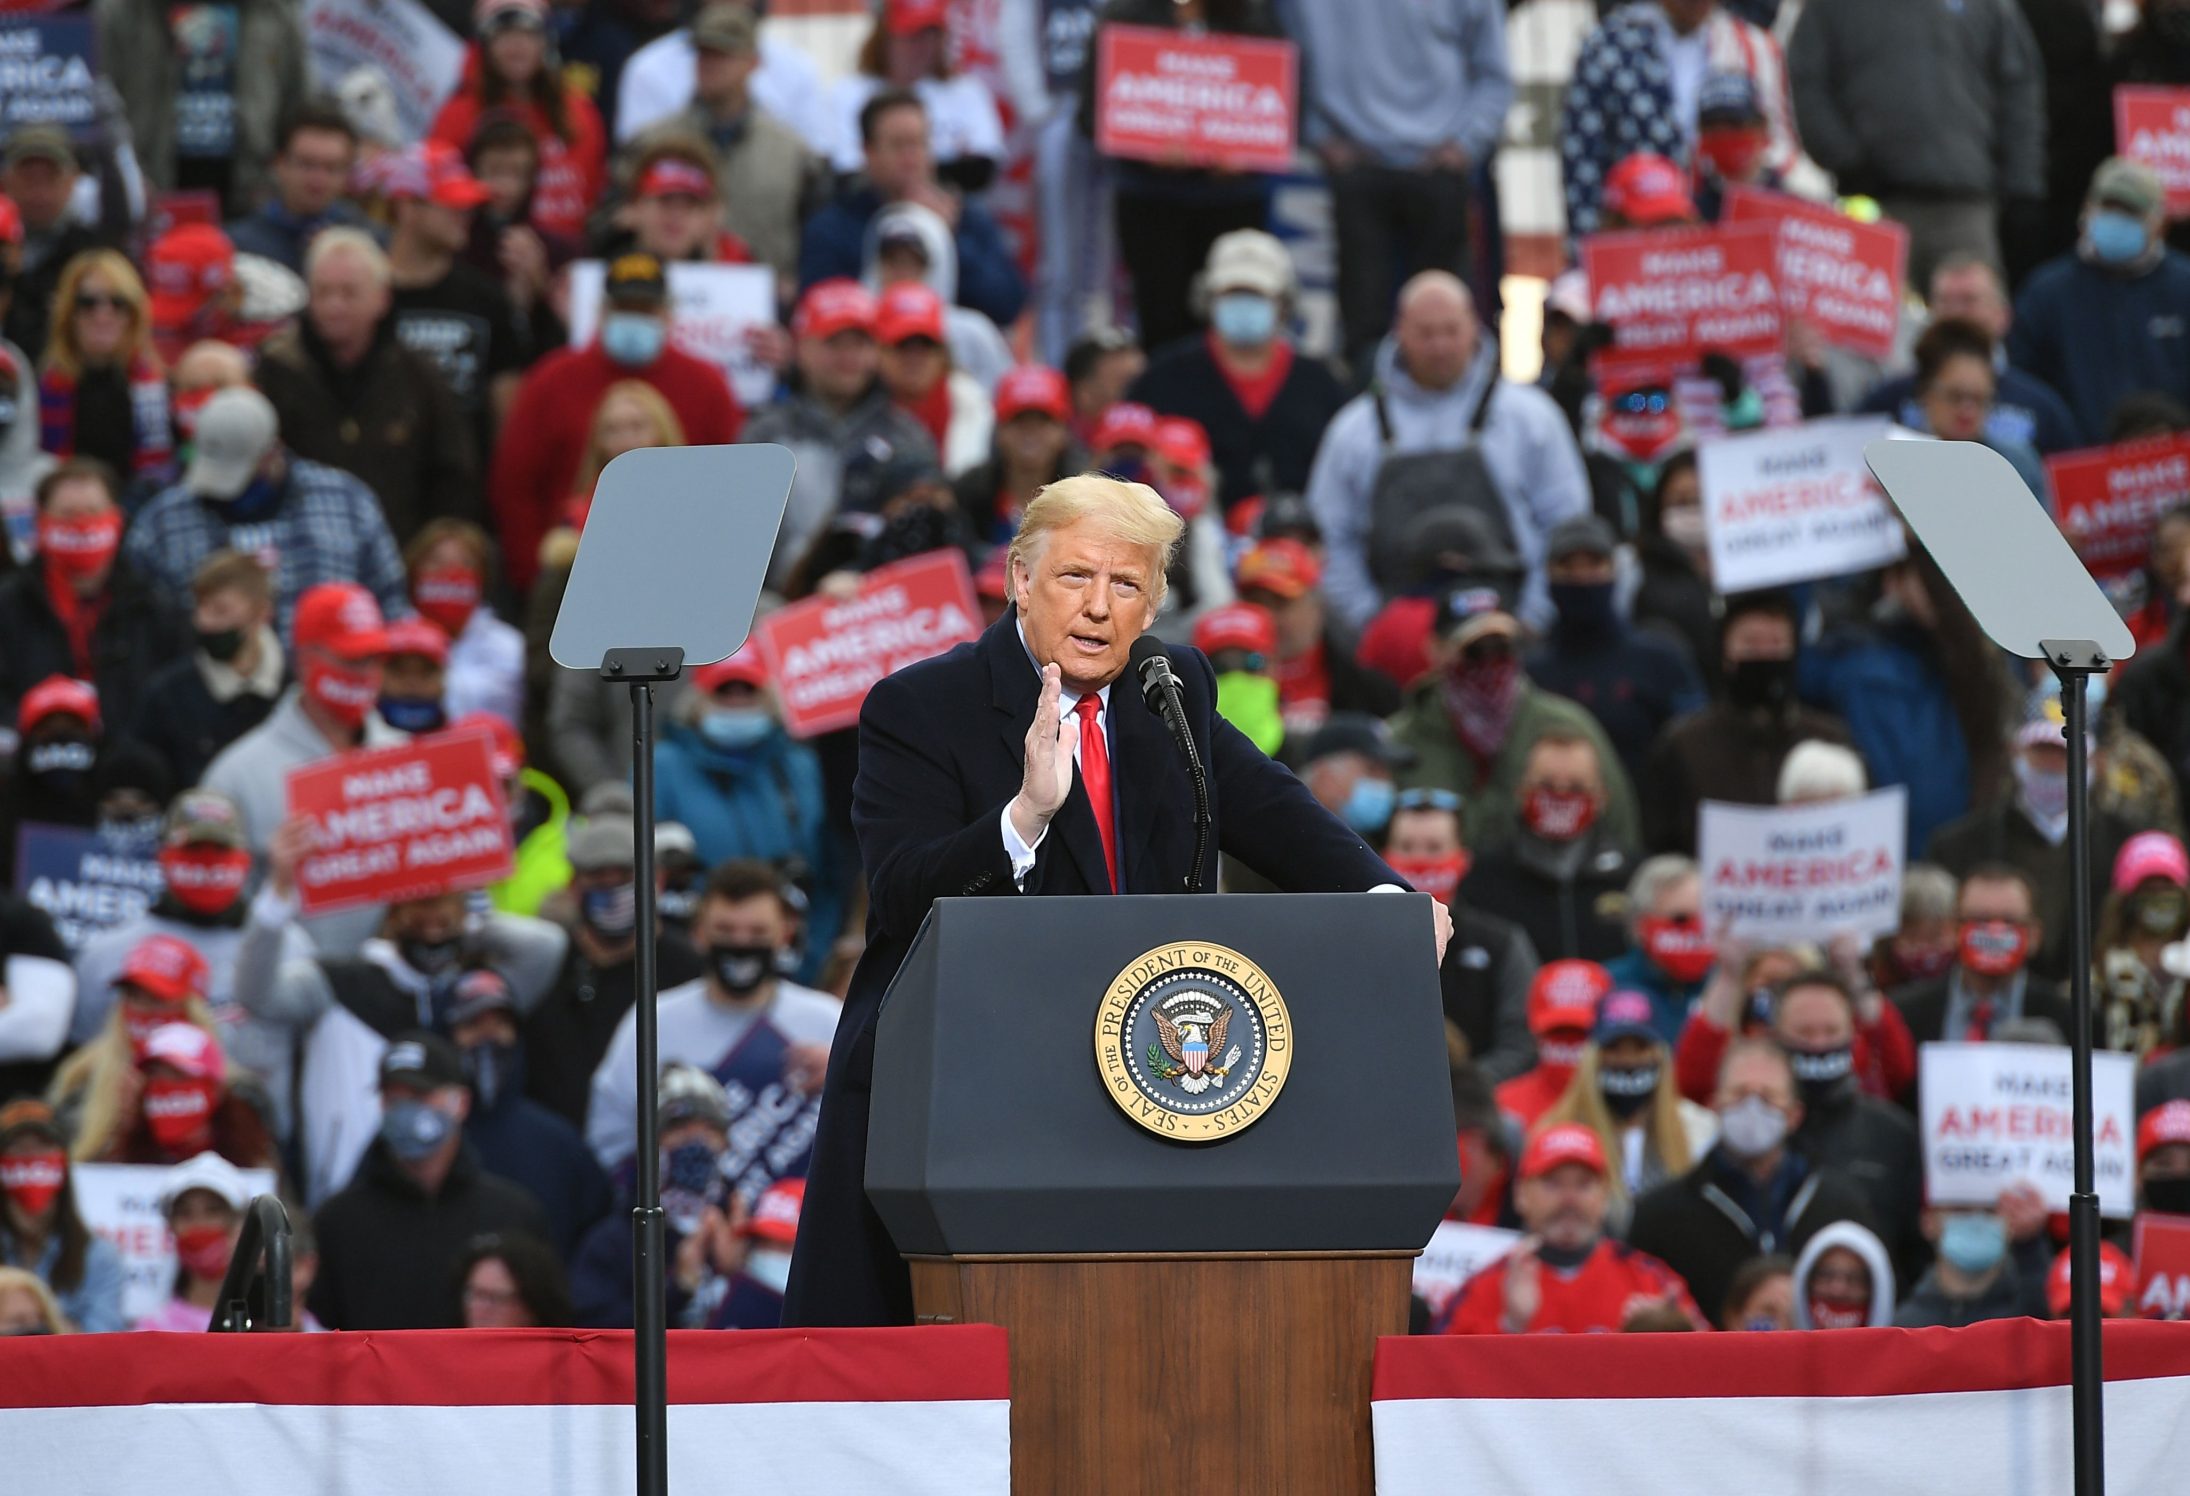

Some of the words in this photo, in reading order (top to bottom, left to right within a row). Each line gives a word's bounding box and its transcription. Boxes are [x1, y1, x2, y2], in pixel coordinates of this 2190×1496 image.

[1109, 73, 1286, 116] AMERICA
[1600, 270, 1776, 320] AMERICA
[1614, 316, 1688, 346] REAT
[786, 603, 974, 680] AMERICA
[344, 760, 431, 799] MAKE
[304, 842, 398, 886] GREAT
[408, 829, 502, 867] AGAIN
[1715, 843, 1893, 890] AMERICA
[1192, 951, 1211, 963] OF
[1215, 955, 1239, 975] THE
[1102, 949, 1186, 1038] PRESIDENT
[1244, 972, 1286, 1052] UNITED
[1104, 1044, 1118, 1071] THE
[1113, 1074, 1129, 1092] OF
[1214, 1070, 1278, 1130] STATES
[1997, 1071, 2072, 1098] MAKE
[1130, 1091, 1178, 1131] SEAL
[1939, 1104, 2122, 1144] AMERIA
[1940, 1150, 2033, 1174] GREAT
[2045, 1153, 2124, 1180] AGIN
